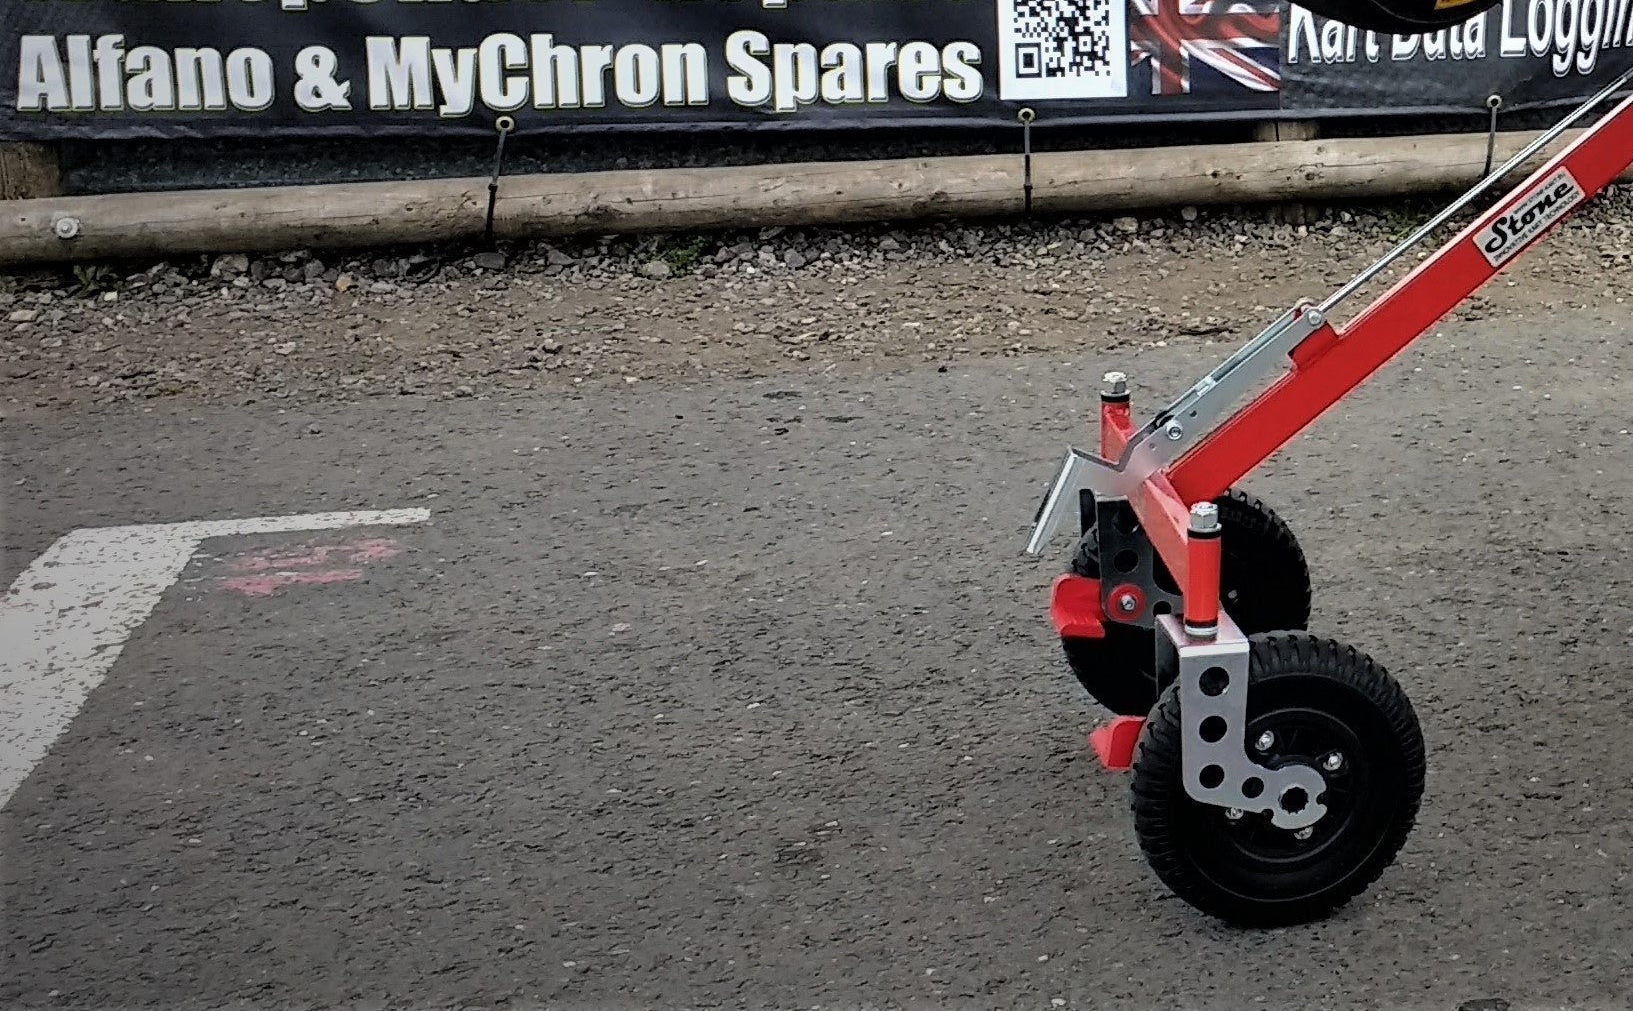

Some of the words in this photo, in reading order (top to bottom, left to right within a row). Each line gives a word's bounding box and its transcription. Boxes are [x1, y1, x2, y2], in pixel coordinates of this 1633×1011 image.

[17, 33, 276, 111] Alfano
[294, 45, 352, 110] &
[365, 33, 710, 117] MyChron
[725, 29, 984, 113] Spares
[1484, 182, 1575, 254] Stone
